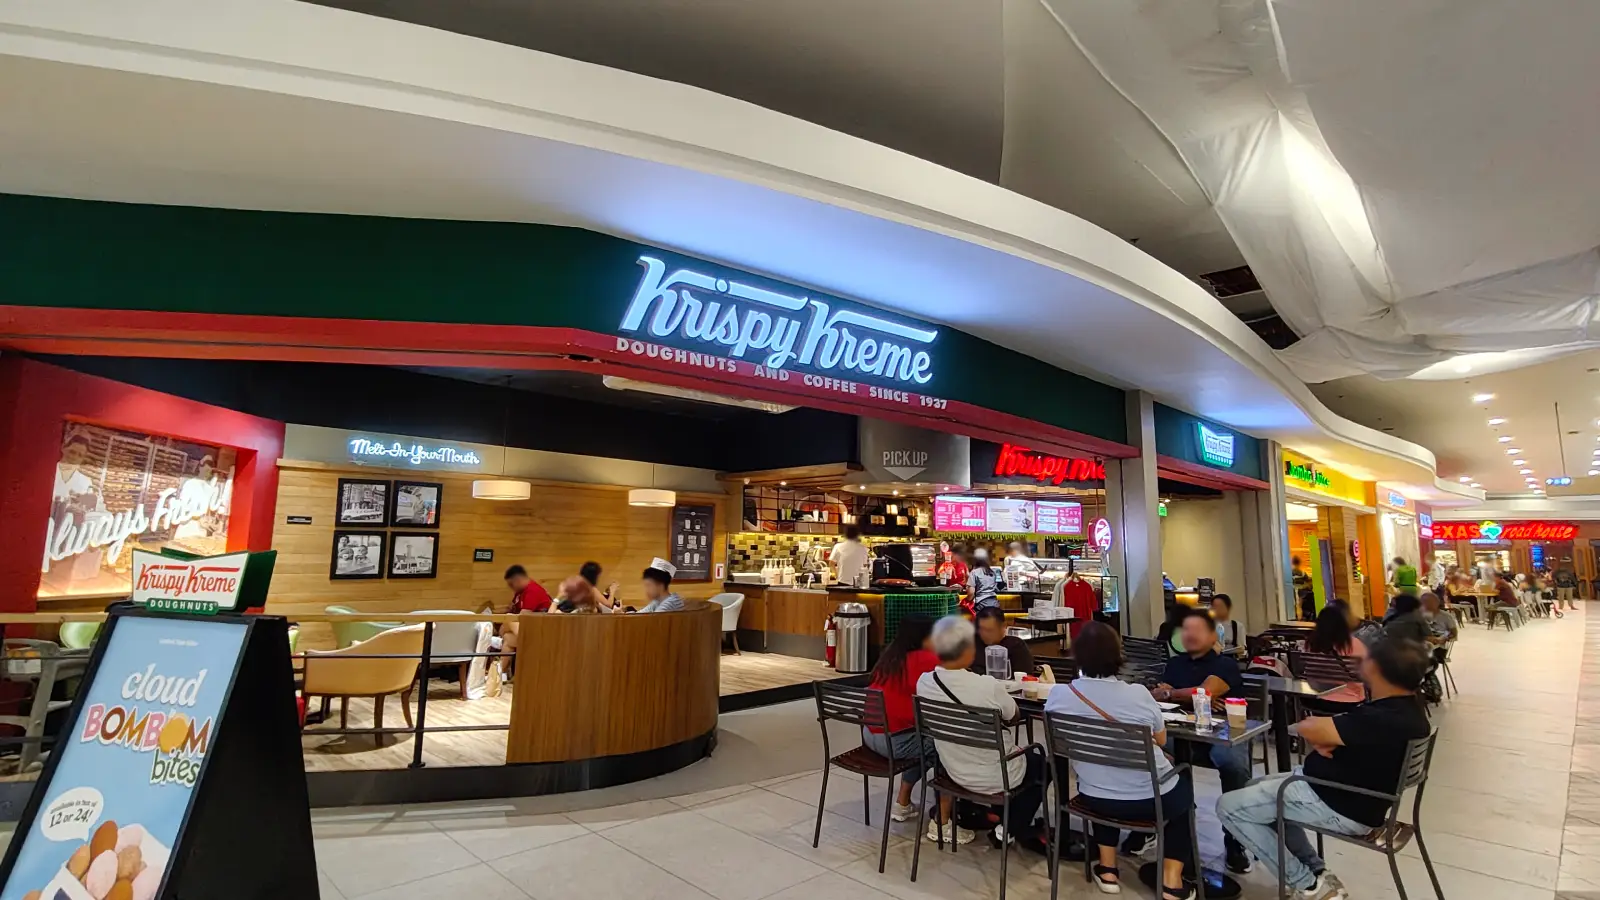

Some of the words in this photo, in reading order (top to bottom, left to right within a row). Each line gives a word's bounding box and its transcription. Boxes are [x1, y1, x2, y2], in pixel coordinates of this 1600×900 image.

[618, 256, 808, 368] Krispy
[800, 300, 938, 384] Kreme
[617, 337, 737, 373] DOUGHNUTS
[754, 365, 790, 382] AND
[803, 374, 857, 394] COFFEE
[869, 385, 909, 404] SINCE
[919, 395, 947, 410] 1937
[882, 450, 910, 466] PICK
[912, 451, 928, 467] UP
[1433, 525, 1481, 539] EXAS
[136, 563, 187, 596] Krispy
[184, 565, 240, 594] Kreme
[150, 600, 215, 612] DOUGHNUTS
[121, 663, 208, 706] cloud
[151, 750, 200, 786] bites
[49, 811, 63, 828] 12
[63, 813, 74, 823] or
[74, 808, 94, 823] 24!
